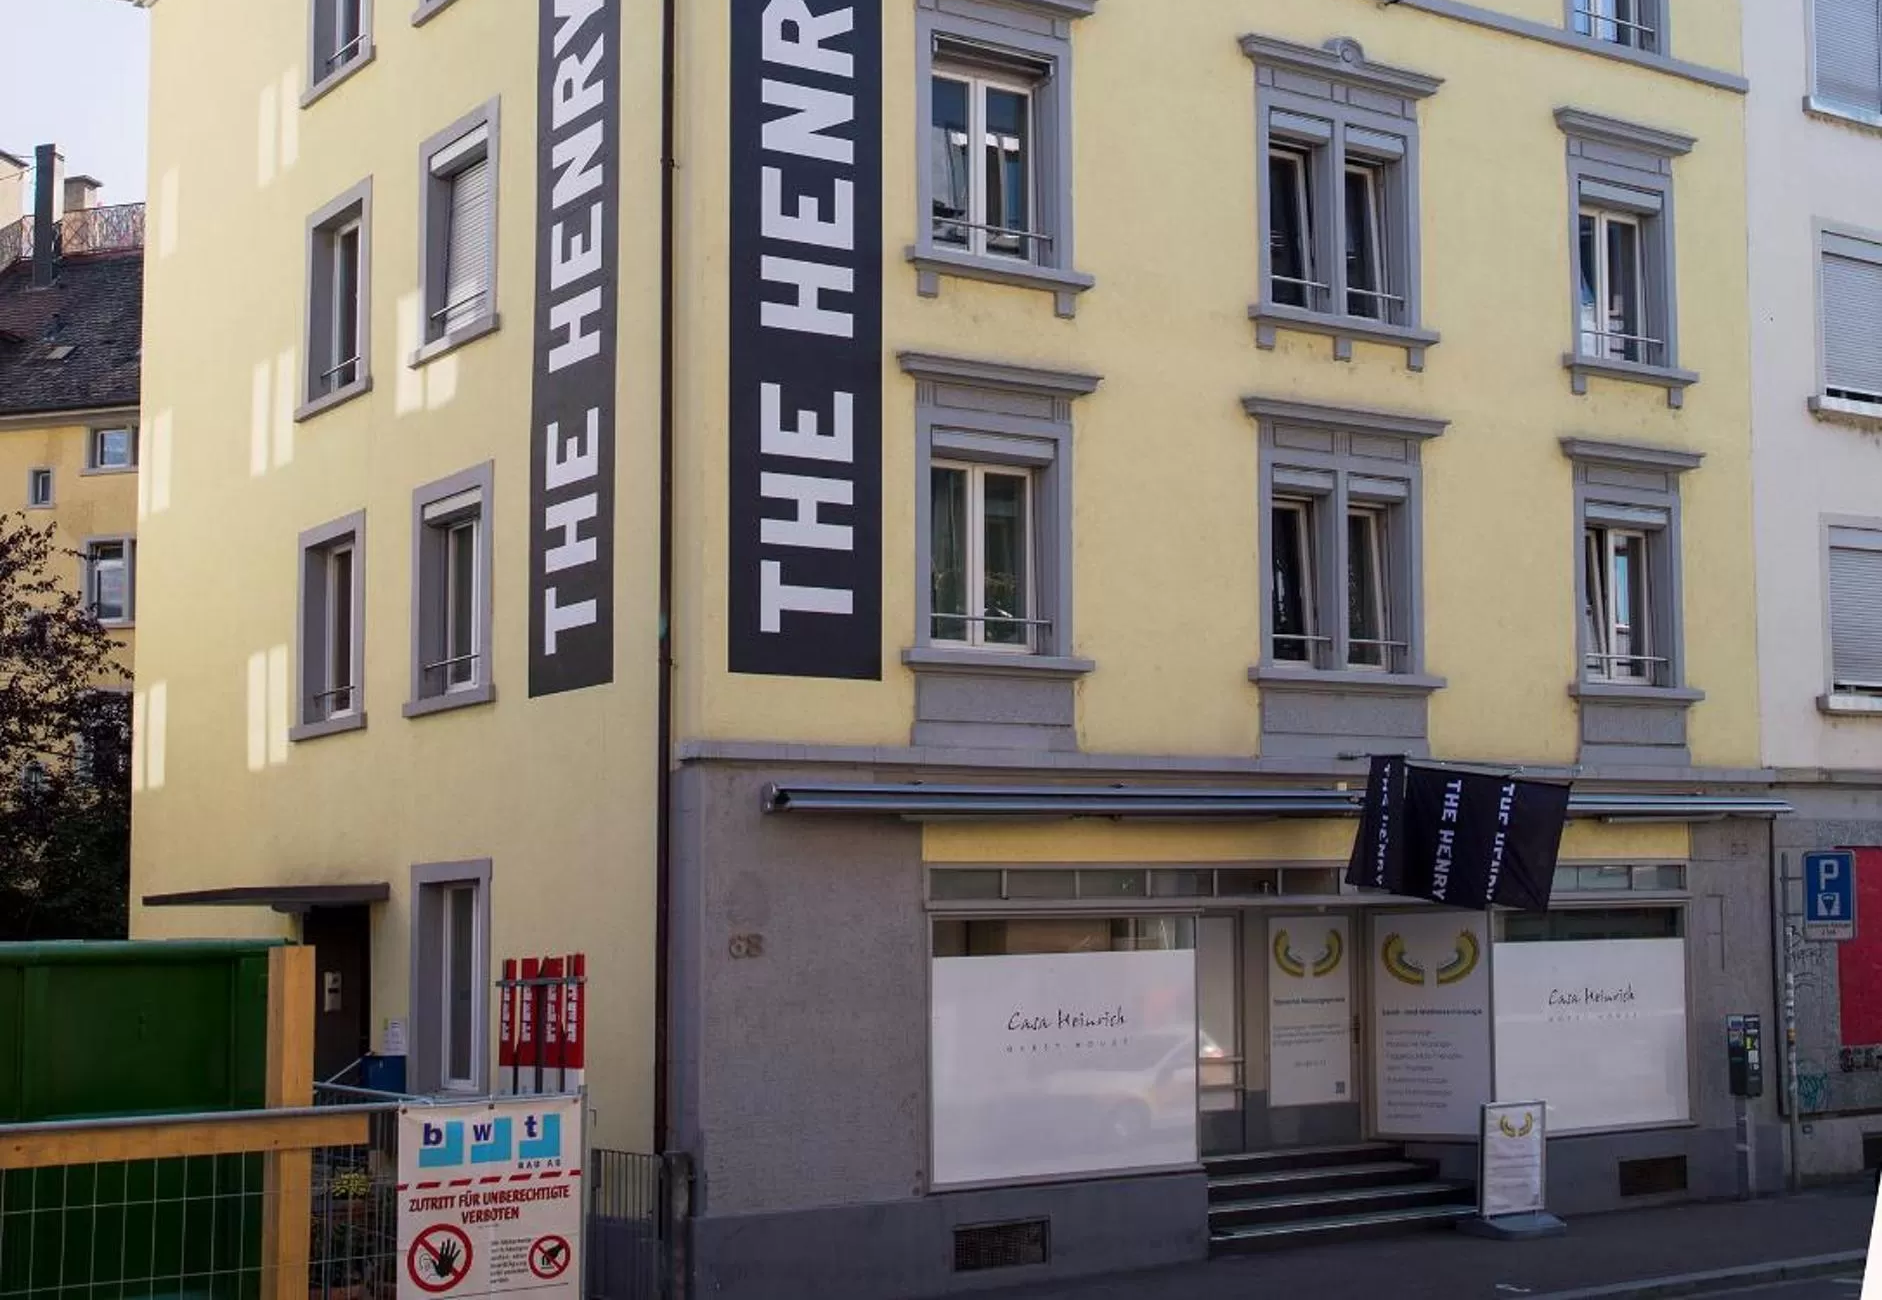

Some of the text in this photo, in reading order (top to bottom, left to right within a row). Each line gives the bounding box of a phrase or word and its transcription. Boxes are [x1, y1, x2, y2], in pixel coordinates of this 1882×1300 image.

[760, 382, 854, 633] THE
[546, 406, 599, 656] THE
[1431, 779, 1462, 901] THE HENRY
[1819, 859, 1839, 892] P
[1007, 1004, 1125, 1031] Casa Heinrich
[408, 1184, 571, 1213] ZUTRITT FÜR UNBERECHTIGTE
[461, 1206, 520, 1225] VERBOTEN
